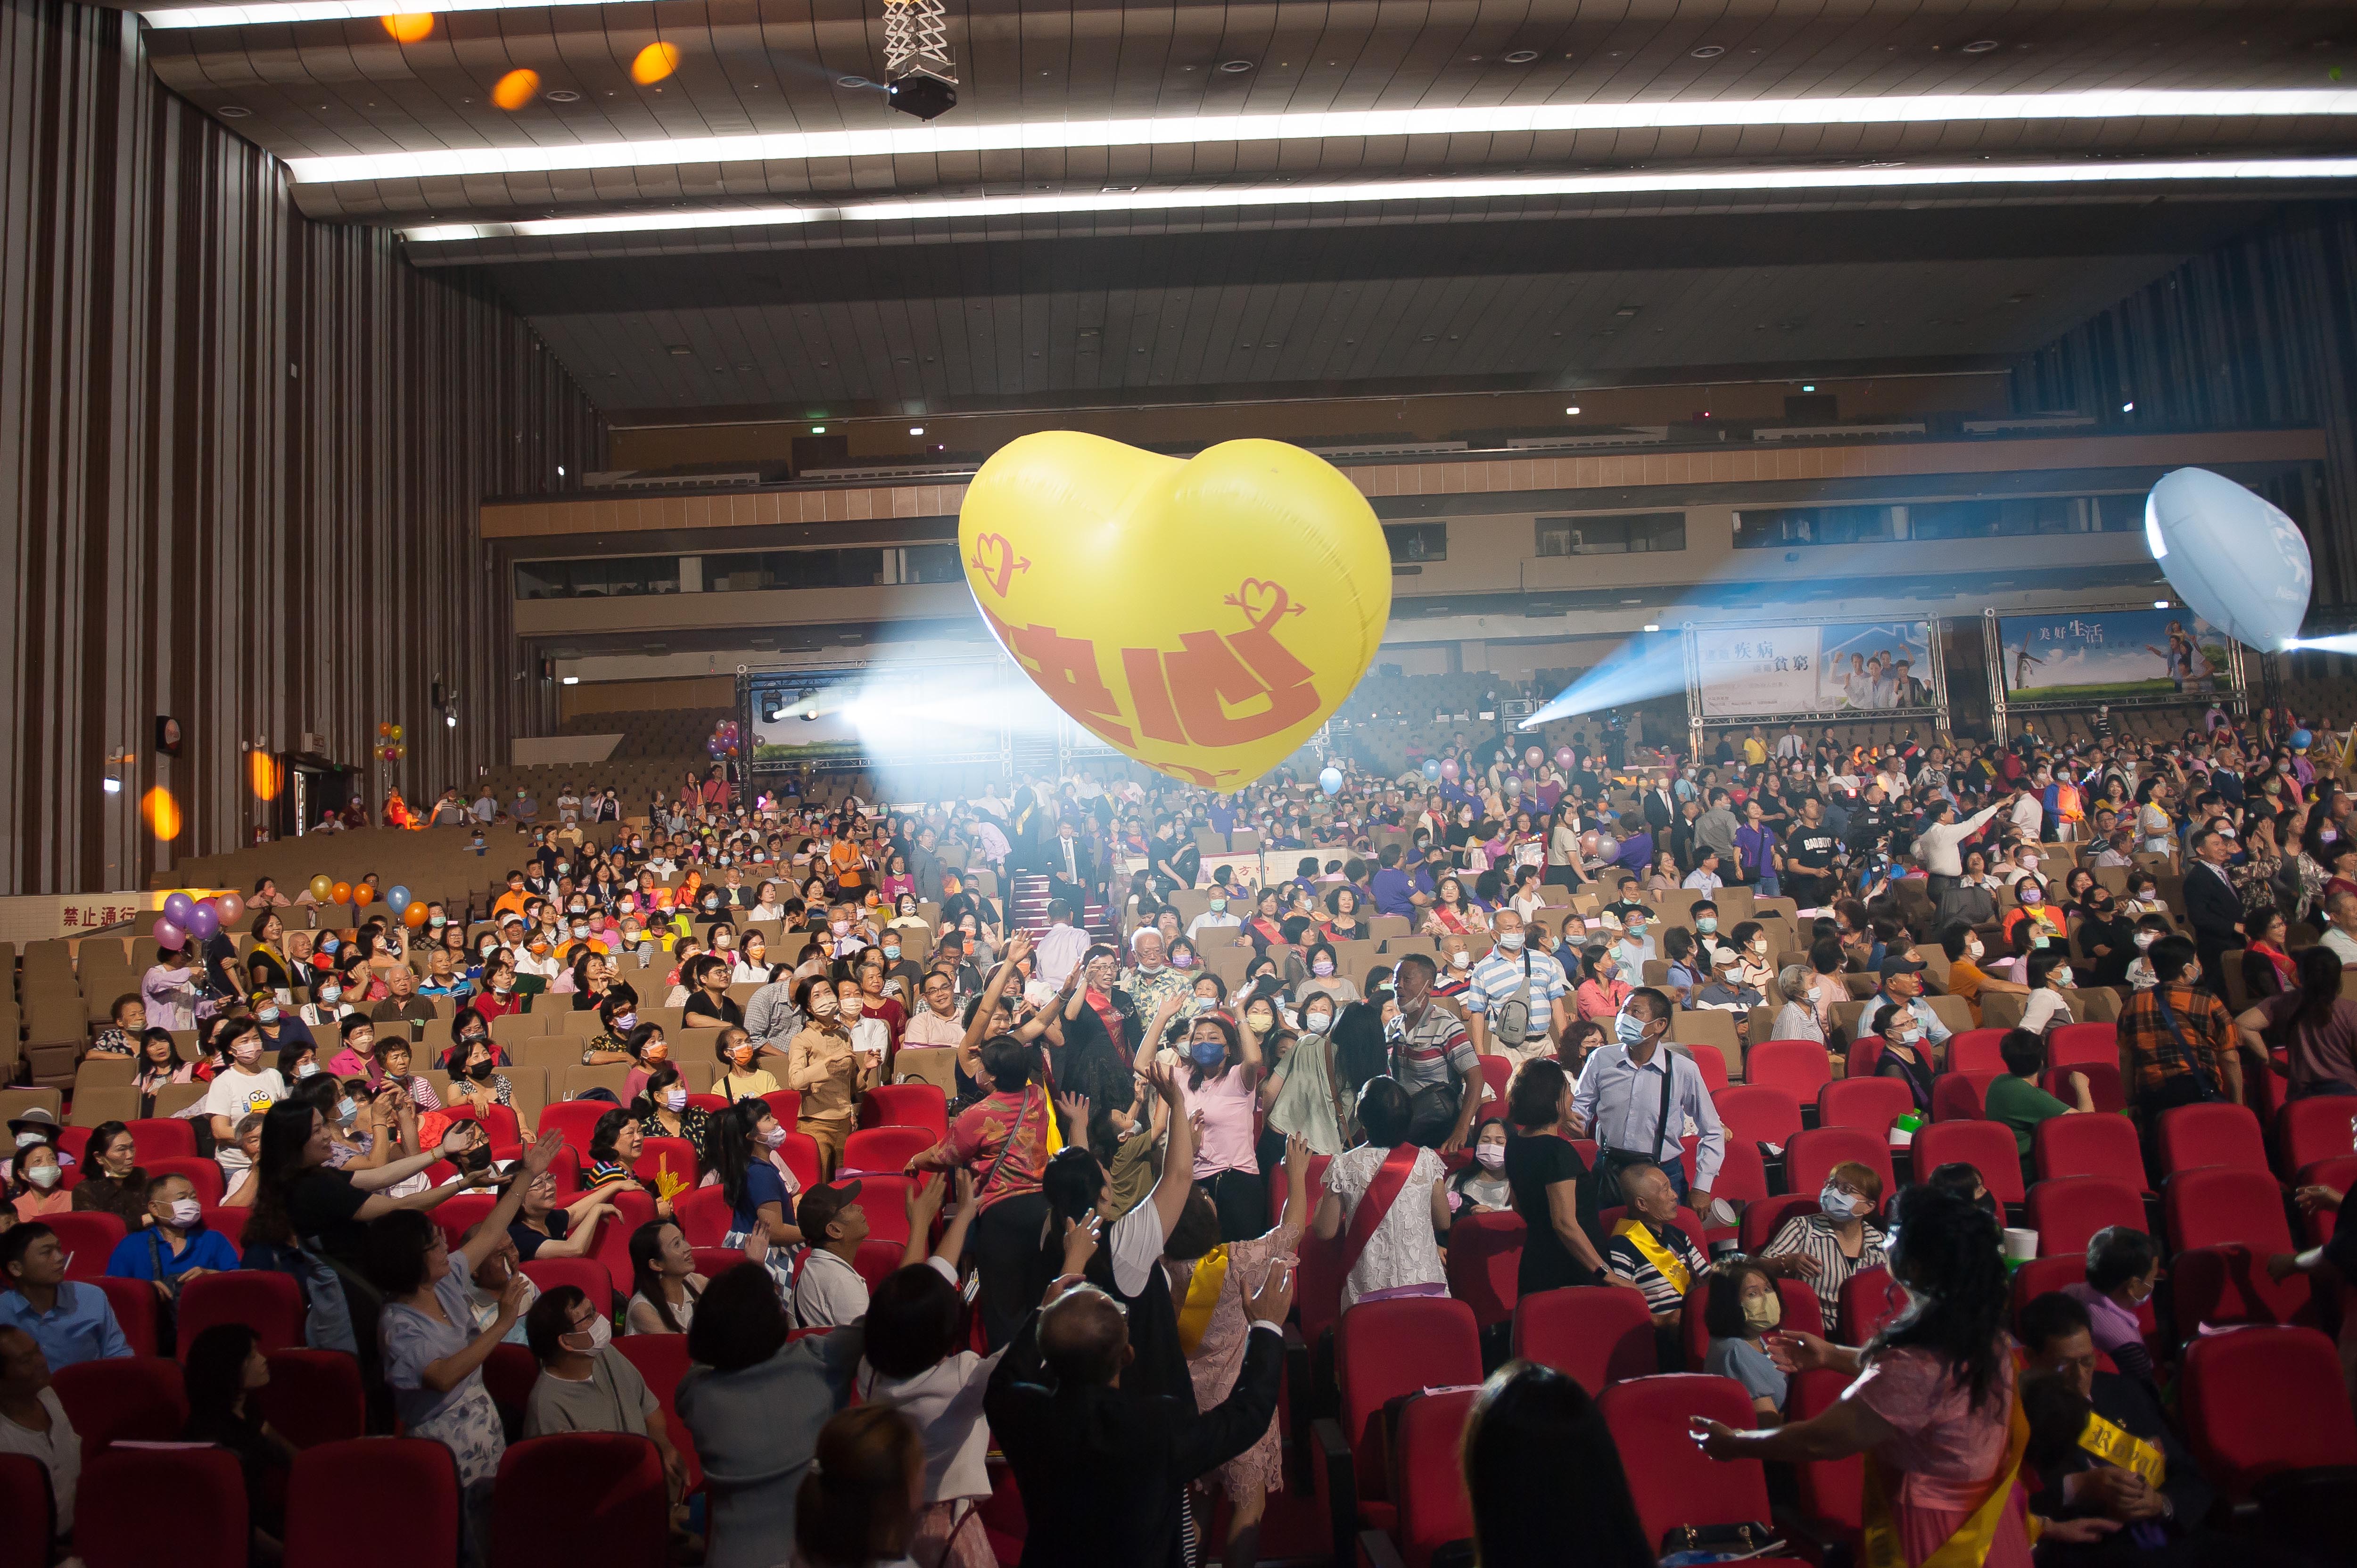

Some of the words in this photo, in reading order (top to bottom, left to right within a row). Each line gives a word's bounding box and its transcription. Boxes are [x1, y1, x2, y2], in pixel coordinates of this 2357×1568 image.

[2039, 619, 2103, 643] 美好生活
[64, 906, 135, 927] 禁止通行
